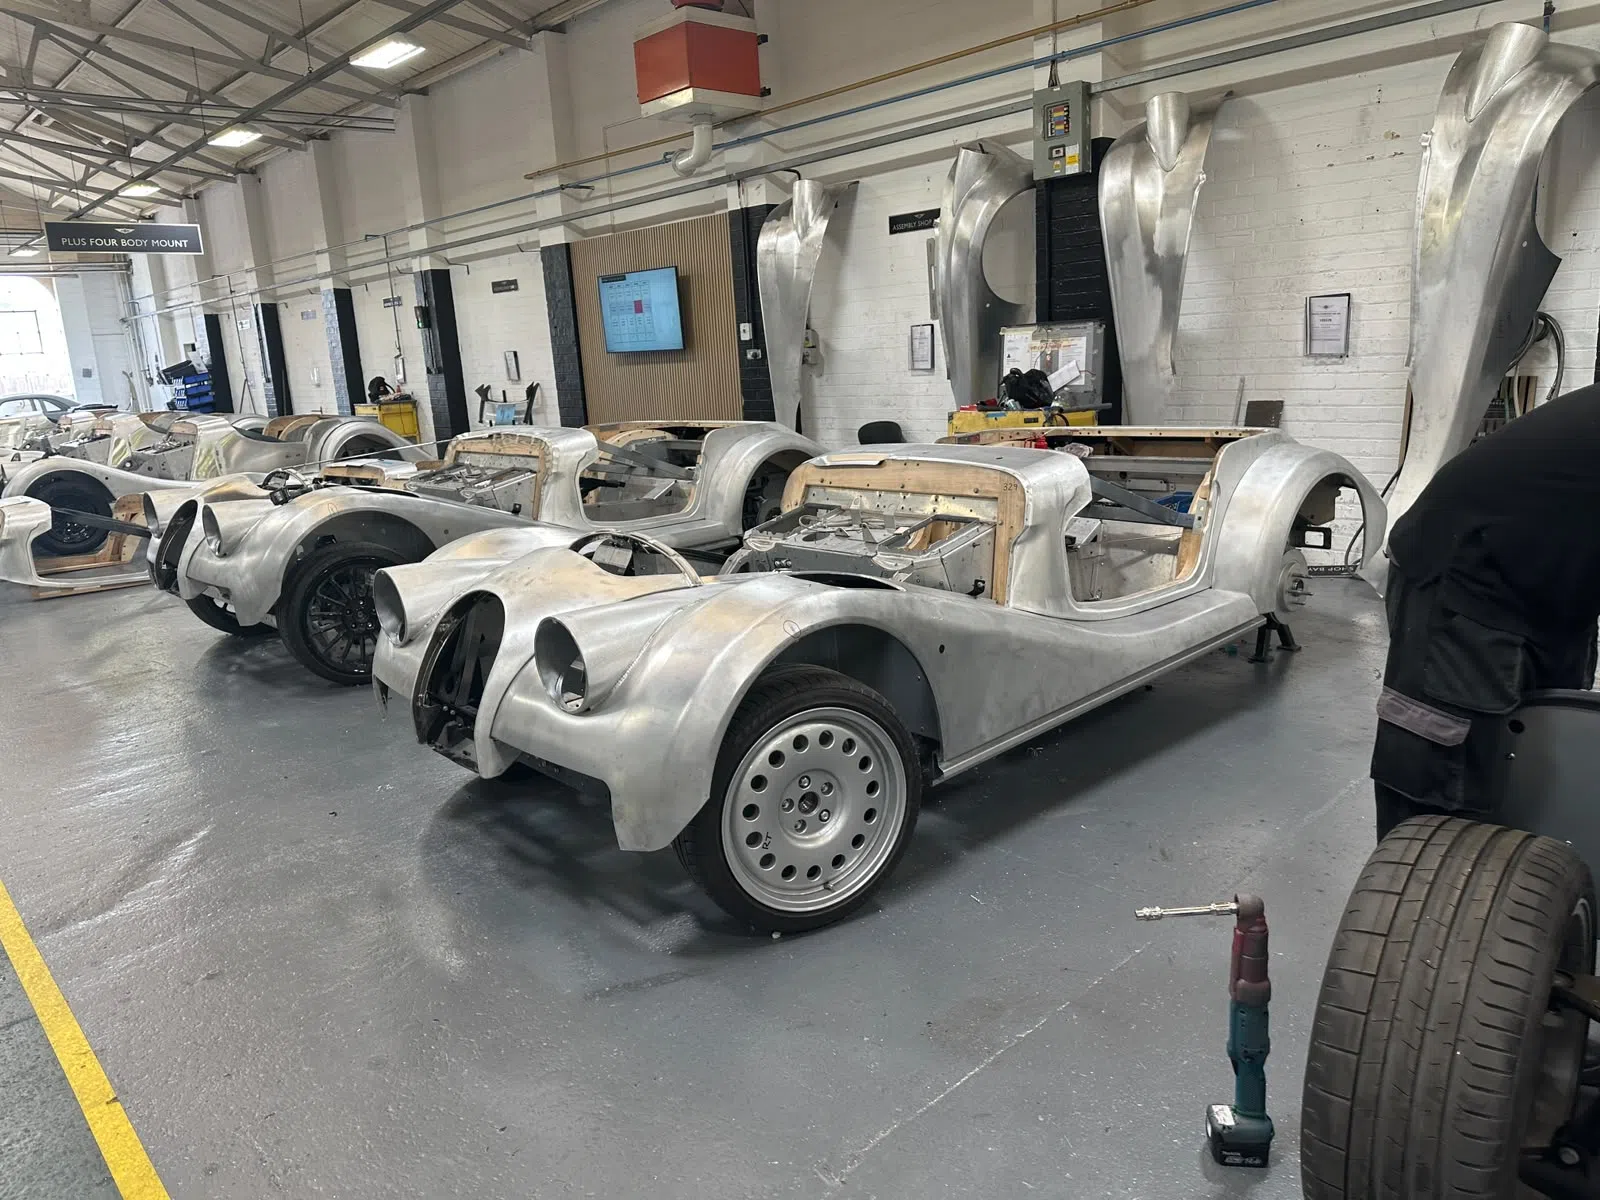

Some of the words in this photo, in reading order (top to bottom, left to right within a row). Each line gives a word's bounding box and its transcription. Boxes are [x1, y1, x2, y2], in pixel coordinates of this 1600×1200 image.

[892, 221, 917, 231] ASSEMBLY
[917, 219, 932, 227] SHOP
[61, 237, 87, 247] PLUS
[89, 238, 119, 248] FOUR
[121, 239, 148, 248] BODY
[152, 239, 189, 249] MOUNT
[1003, 482, 1018, 492] 329
